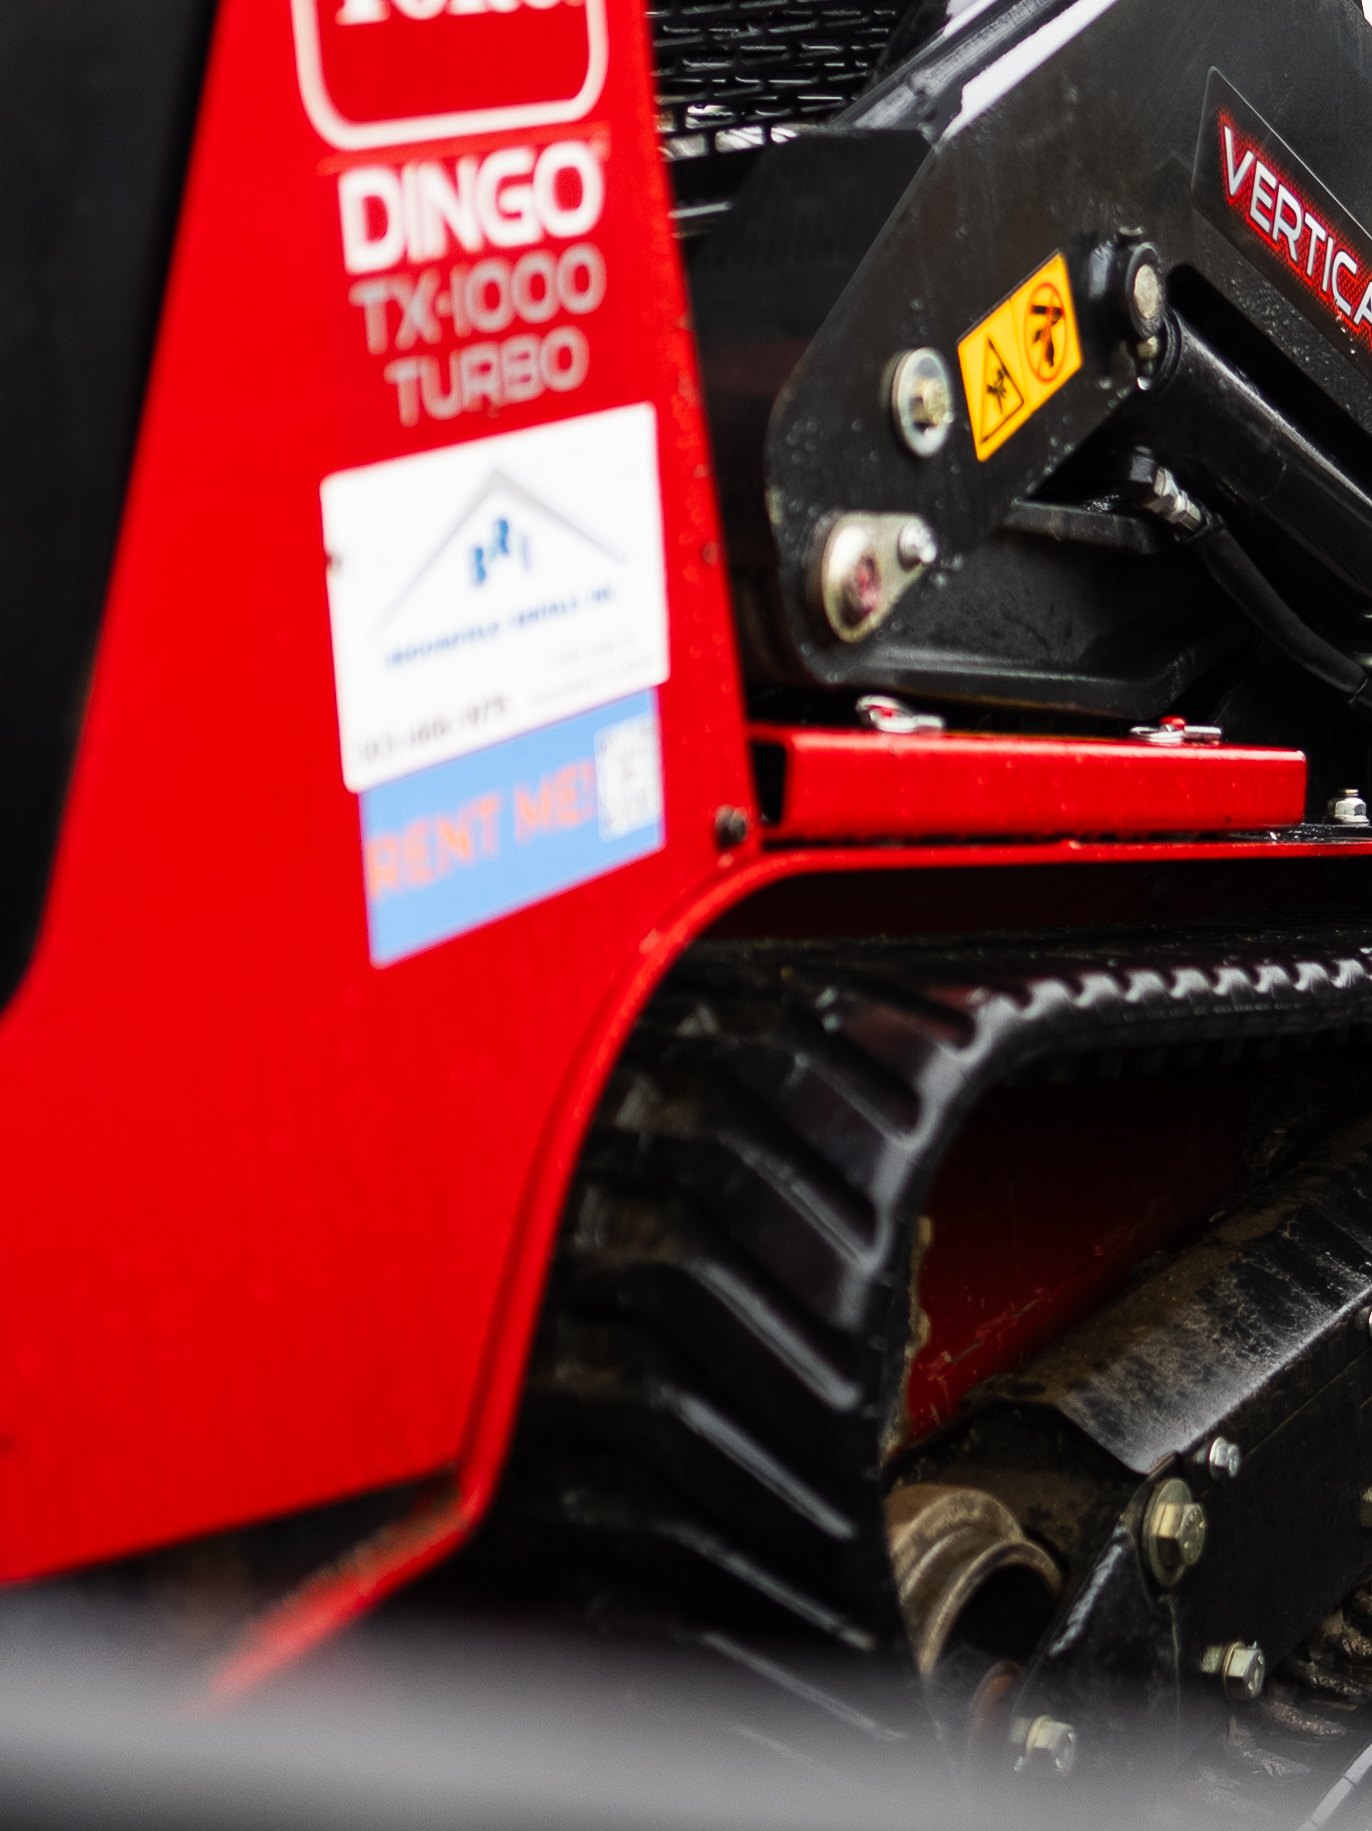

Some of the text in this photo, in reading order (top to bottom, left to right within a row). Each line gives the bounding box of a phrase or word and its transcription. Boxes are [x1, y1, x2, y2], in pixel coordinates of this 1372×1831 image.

[338, 140, 603, 275] DINGO
[348, 242, 607, 356] TX-1000
[383, 325, 590, 428] TURBO
[366, 788, 503, 902] RENT
